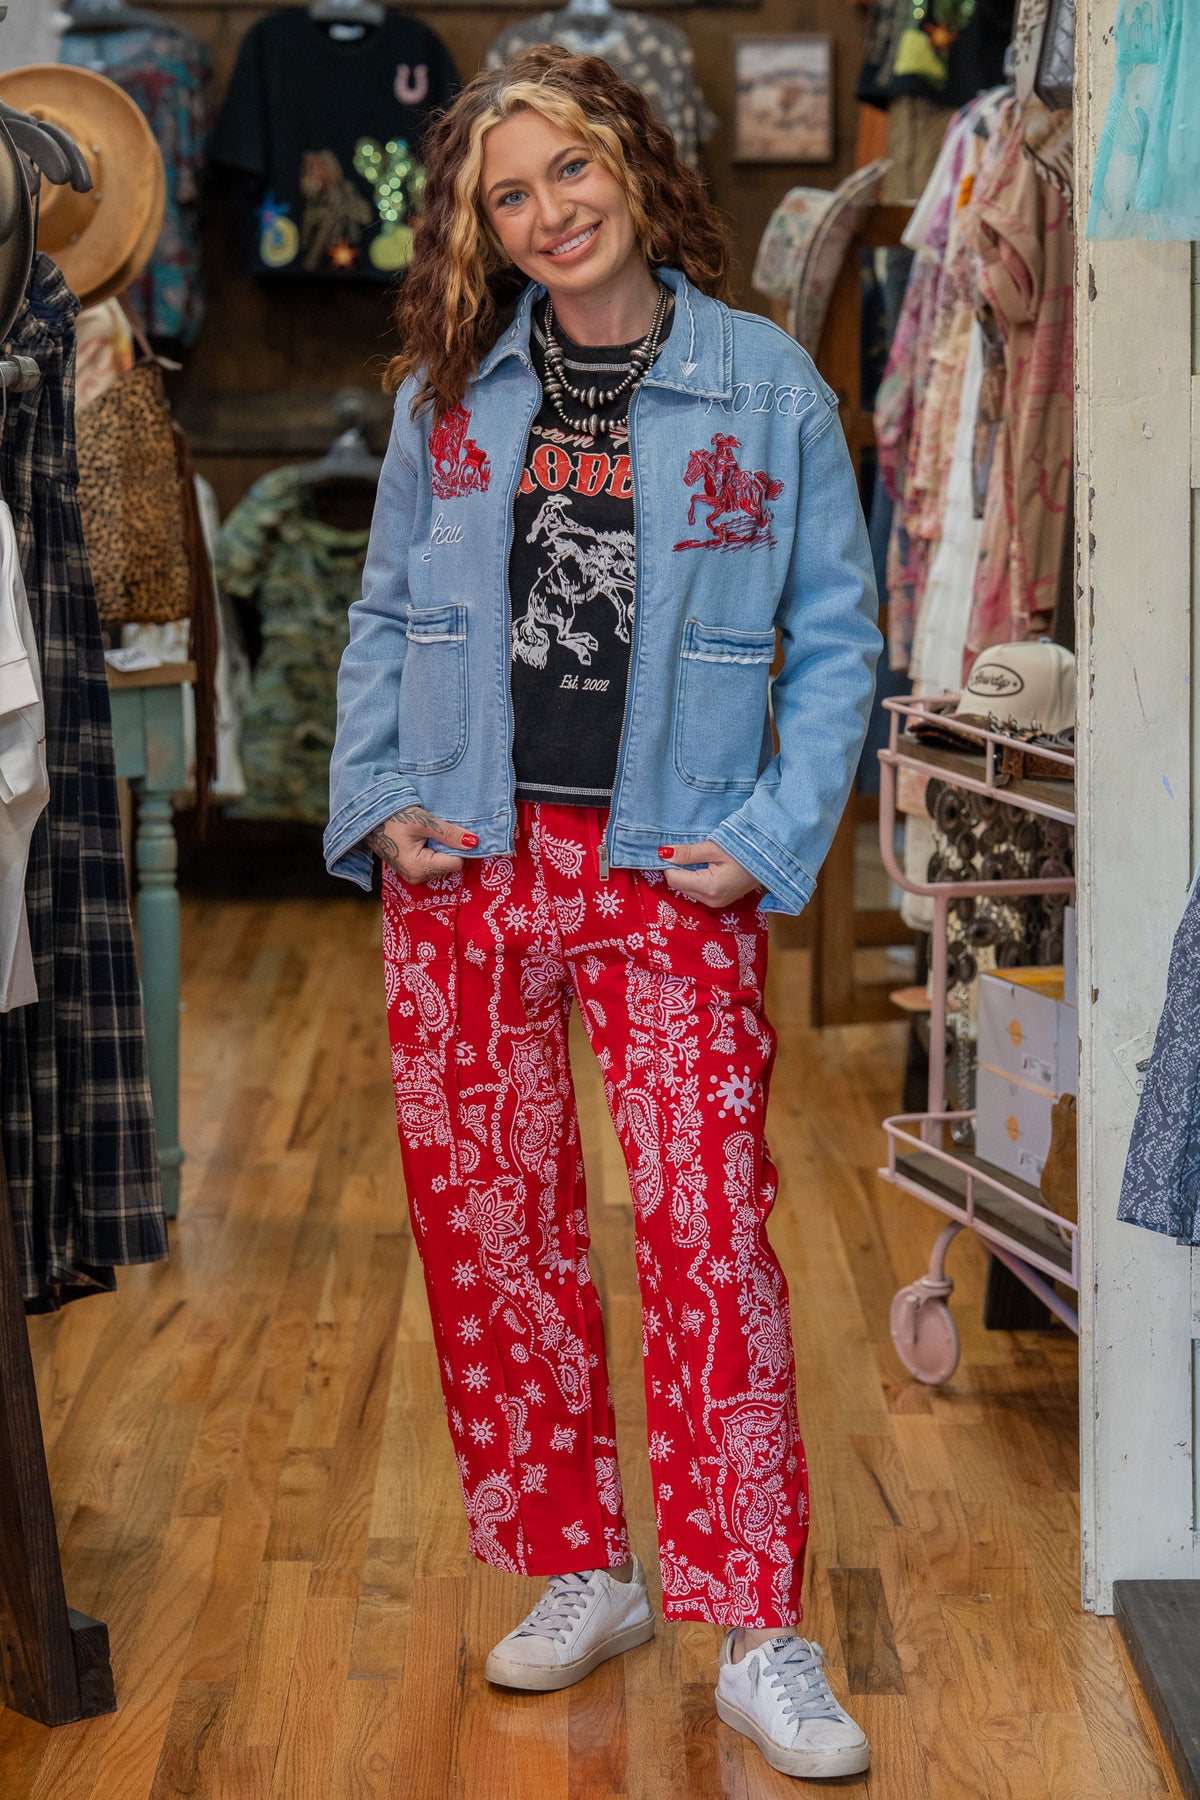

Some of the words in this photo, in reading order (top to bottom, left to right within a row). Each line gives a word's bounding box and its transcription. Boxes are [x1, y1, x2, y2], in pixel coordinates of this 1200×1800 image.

[514, 443, 634, 499] ODE
[559, 673, 580, 690] Est.
[582, 677, 610, 692] 2002
